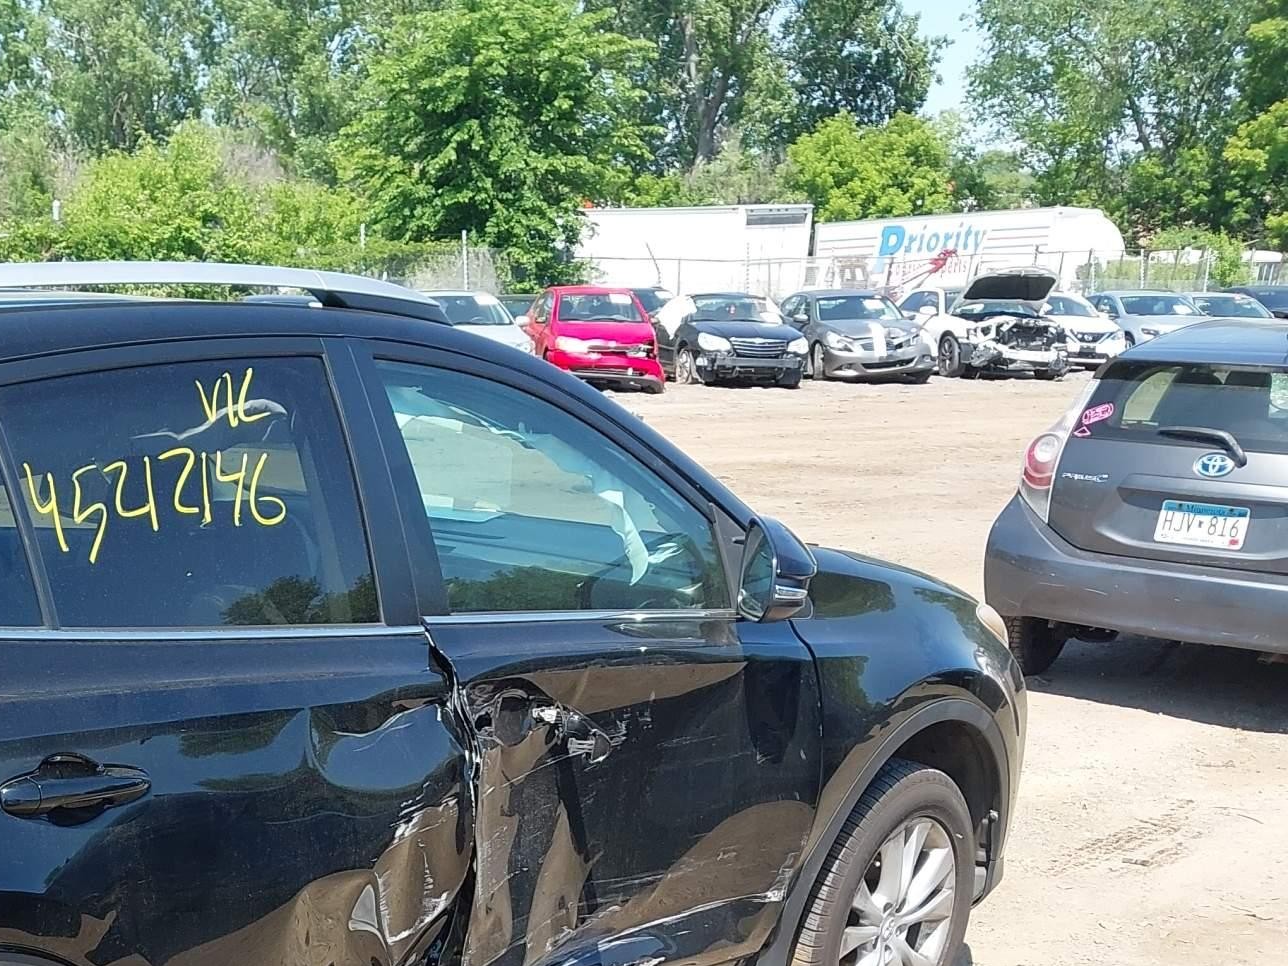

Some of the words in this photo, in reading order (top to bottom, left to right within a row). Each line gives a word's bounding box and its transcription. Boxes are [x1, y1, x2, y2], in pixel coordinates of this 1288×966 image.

[872, 222, 986, 272] Priority
[23, 447, 287, 564] 45212146
[1207, 515, 1240, 538] 816
